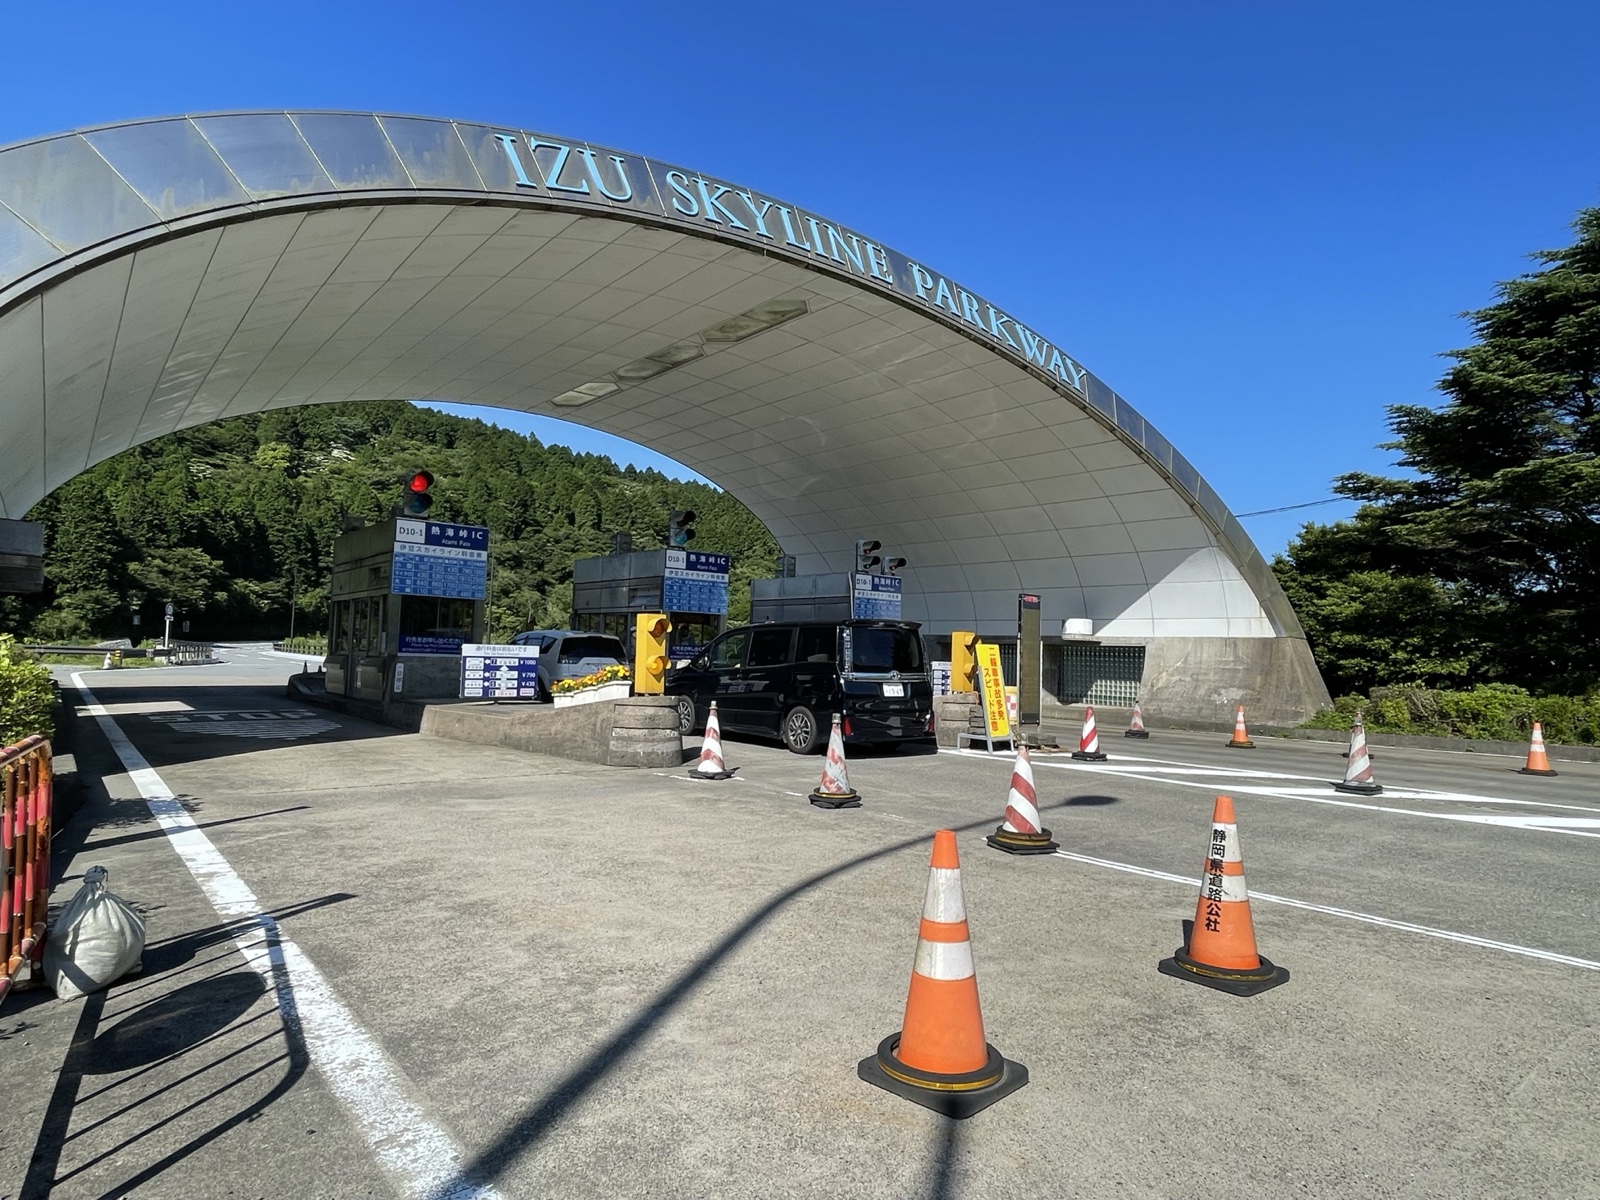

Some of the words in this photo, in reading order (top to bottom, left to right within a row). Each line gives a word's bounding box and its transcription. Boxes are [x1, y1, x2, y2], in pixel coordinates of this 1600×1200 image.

[495, 134, 632, 200] IZU
[666, 170, 893, 285] SKYLINE
[908, 261, 1087, 394] PARKWAY
[399, 527, 423, 537] D10-1
[431, 525, 484, 540] 熱海峠IC
[399, 544, 483, 559] 伊豆スカイライン料金表
[668, 556, 685, 564] D10-1
[989, 647, 1005, 721] 二輪車事故多発
[984, 668, 999, 732] スピード注意
[147, 711, 318, 723] STOP
[1205, 828, 1226, 933] 静岡県道路公社
